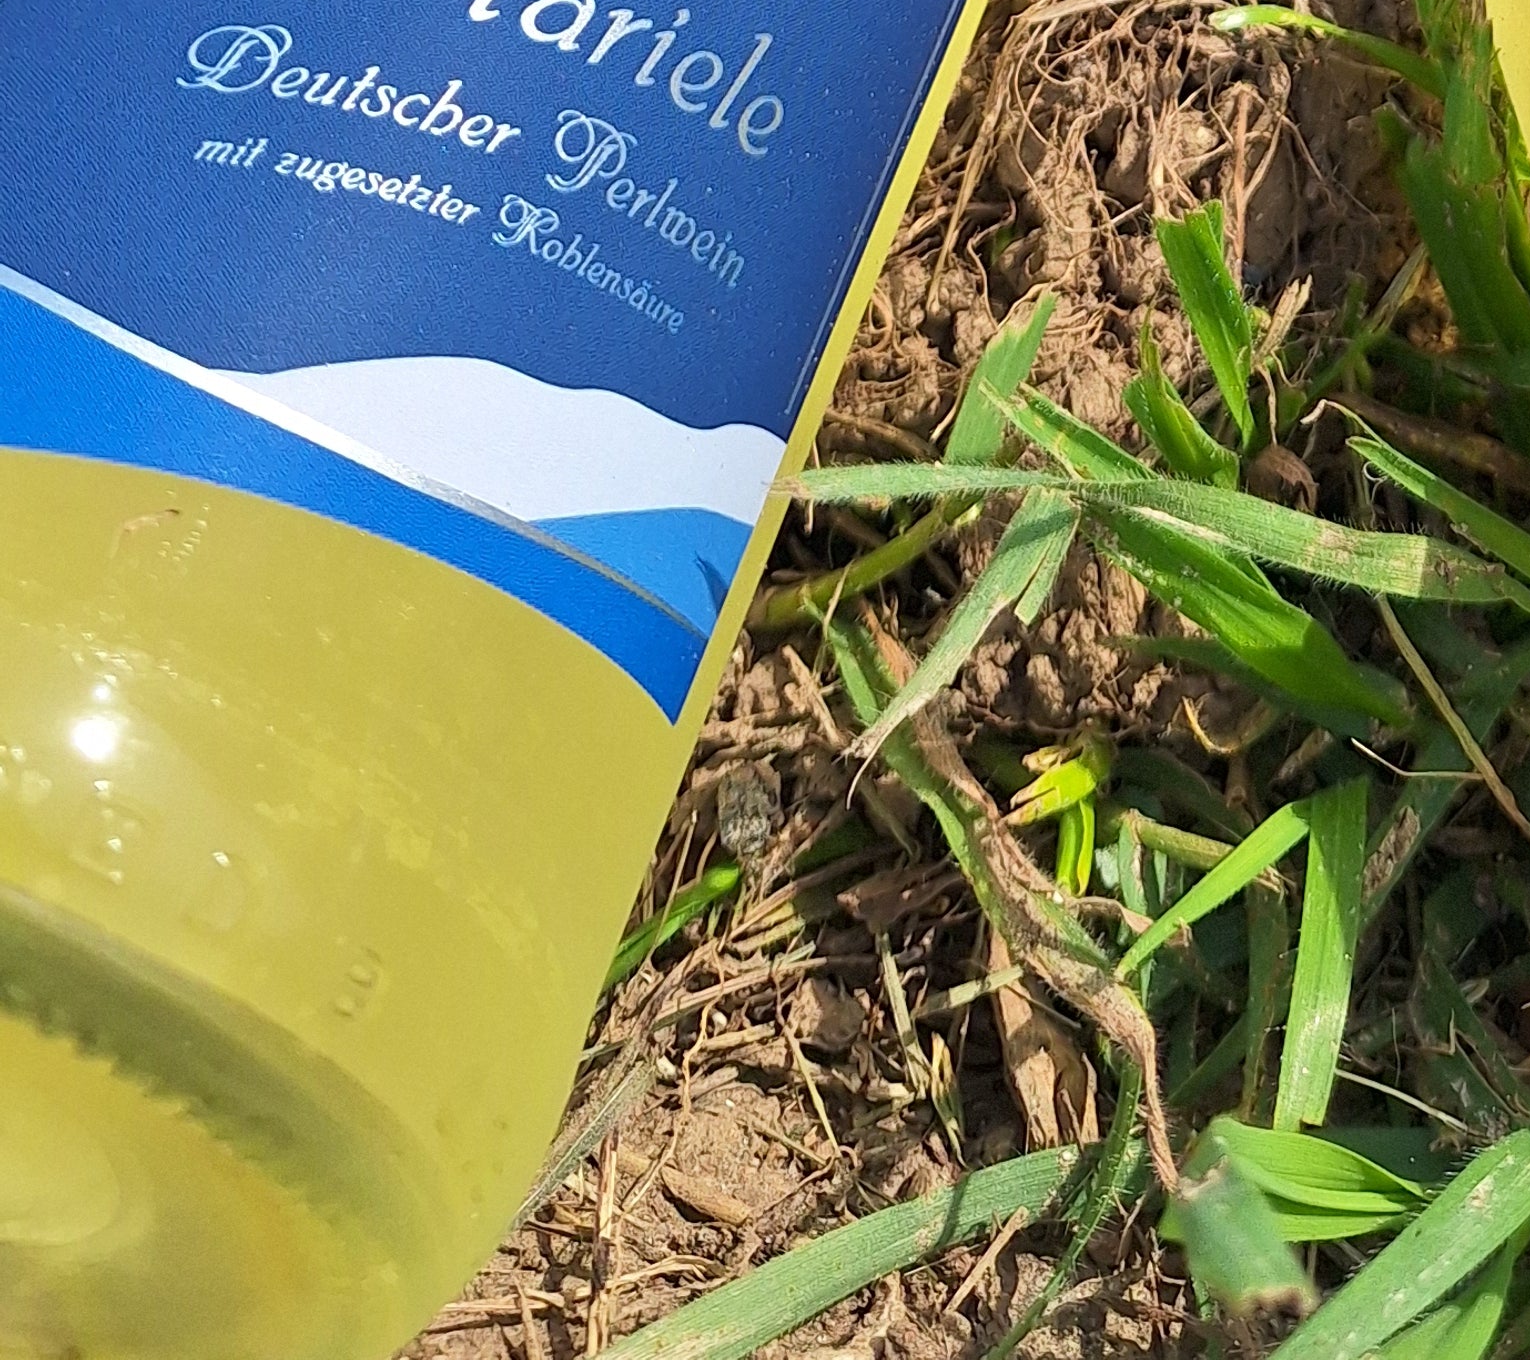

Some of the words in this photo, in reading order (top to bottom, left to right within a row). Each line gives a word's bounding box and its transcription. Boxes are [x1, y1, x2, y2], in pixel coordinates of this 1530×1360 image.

[176, 23, 522, 156] Deutscher
[545, 109, 745, 288] Perlwein
[194, 138, 269, 169] mit
[274, 148, 481, 227] zugesetzter
[492, 194, 684, 334] Kohlensäure
